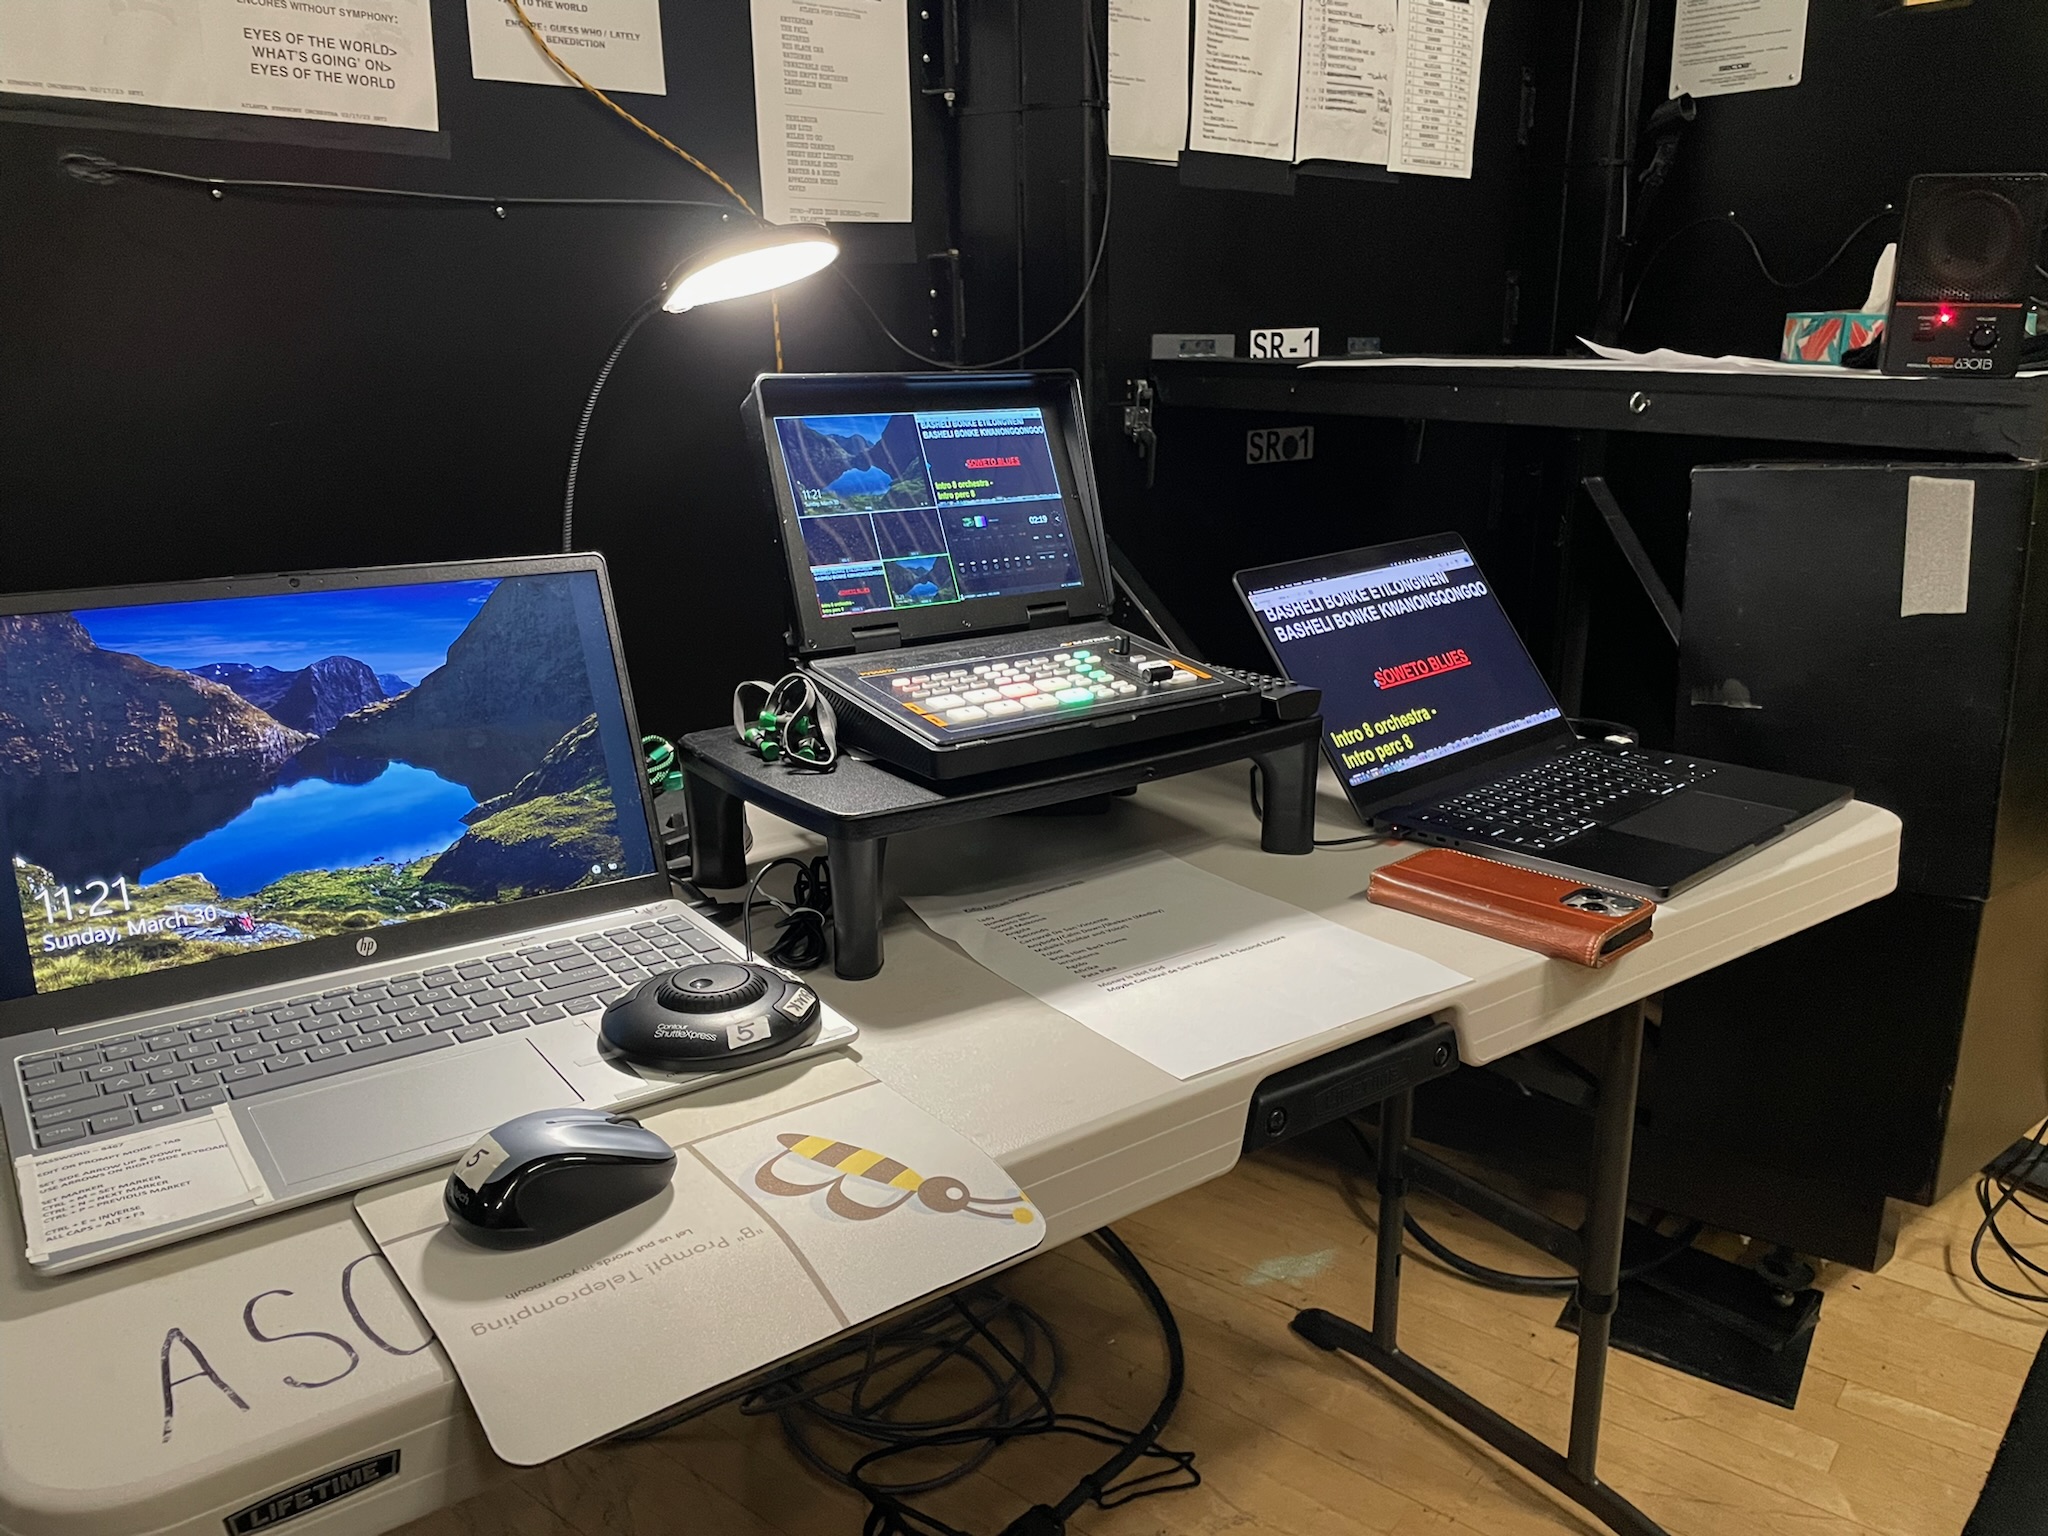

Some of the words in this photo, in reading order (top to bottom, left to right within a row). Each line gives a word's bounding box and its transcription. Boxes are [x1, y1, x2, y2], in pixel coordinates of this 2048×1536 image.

[290, 2, 337, 16] WITHOUT
[339, 8, 399, 24] SYMPHONY:
[536, 0, 553, 9] THE
[555, 1, 588, 13] WORLD
[505, 19, 547, 31] ENCRE:
[550, 24, 579, 34] GUESS
[581, 27, 602, 37] WHO
[609, 31, 640, 41] LATELY
[243, 27, 282, 43] EYES
[286, 32, 304, 45] OF
[307, 35, 336, 49] THE
[339, 39, 398, 56] WORLD>
[546, 35, 606, 49] BENEDICTION
[251, 45, 308, 63] WHAT'S
[311, 53, 361, 68] GOING'
[365, 59, 392, 72] ON>
[250, 63, 288, 78] EYES
[293, 67, 311, 80] OF
[315, 70, 343, 84] THE
[346, 73, 396, 89] WORLD
[922, 429, 954, 439] BASHELI
[954, 429, 980, 438] BONKE
[966, 458, 996, 469] SOWETO
[997, 457, 1021, 467] BLUES
[802, 489, 822, 500] 11:21
[934, 482, 951, 491] Intro
[958, 479, 989, 489] orchestra
[937, 492, 954, 500] Intro
[955, 491, 970, 500] perc
[1264, 597, 1325, 622] BASHELI
[1325, 588, 1371, 609] BONKE
[1370, 571, 1450, 599] ETILONGWENI
[1274, 612, 1335, 643] BASHELI
[1332, 604, 1381, 629] BONKE
[1381, 580, 1489, 619] KWANONGQONGQO
[1374, 660, 1428, 687] SOWETO
[1427, 648, 1470, 672] BLUES
[1330, 729, 1364, 748] Intro
[1362, 722, 1374, 738] 8
[1374, 707, 1431, 735] orchestra
[1342, 750, 1376, 770] Intro
[1375, 740, 1404, 763] perc
[1401, 733, 1414, 750] 8
[34, 876, 132, 925] 11:21
[42, 926, 121, 954] Sunday,
[128, 912, 191, 939] March
[194, 904, 218, 923] 30
[356, 937, 378, 957] hp
[654, 1029, 718, 1042] ShuttleXpress
[657, 1023, 688, 1031] Contour
[737, 1022, 756, 1043] 5
[36, 1151, 90, 1166] PASSWORD
[37, 1168, 59, 1177] EDIT
[78, 1154, 119, 1166] PROMPT
[122, 1145, 153, 1156] MODE
[59, 1173, 80, 1182] SIDE
[82, 1164, 121, 1176] ARROW
[149, 1148, 182, 1159] DOWN
[466, 1148, 489, 1168] 5
[39, 1185, 58, 1194] USE
[61, 1173, 105, 1188] ARROWS
[125, 1159, 156, 1171] RIGHT
[157, 1154, 179, 1162] SIDE
[41, 1197, 58, 1205] SET
[61, 1184, 104, 1200] MARKER
[42, 1202, 66, 1211] CTRL
[98, 1186, 116, 1194] SET
[118, 1175, 161, 1189] MARKER
[43, 1208, 67, 1217] CTRL
[97, 1190, 123, 1201] NEXT
[126, 1180, 169, 1193] MARKER
[43, 1213, 68, 1224] CTRL
[97, 1191, 147, 1207] PREVIOUS
[150, 1180, 191, 1194] MARKET
[45, 1226, 69, 1236] CTRL
[98, 1205, 141, 1221] INVERSE
[46, 1234, 64, 1242] ALL
[66, 1226, 94, 1236] CAPS
[105, 1218, 122, 1227] ALT
[658, 1235, 673, 1244] us
[675, 1228, 694, 1239] Let
[636, 1241, 656, 1253] put
[582, 1263, 596, 1272] in
[596, 1250, 635, 1267] words
[551, 1269, 579, 1284] your
[505, 1281, 546, 1300] mouth
[471, 1271, 643, 1336] Teleprompting
[251, 1462, 380, 1529] LIFETIME
